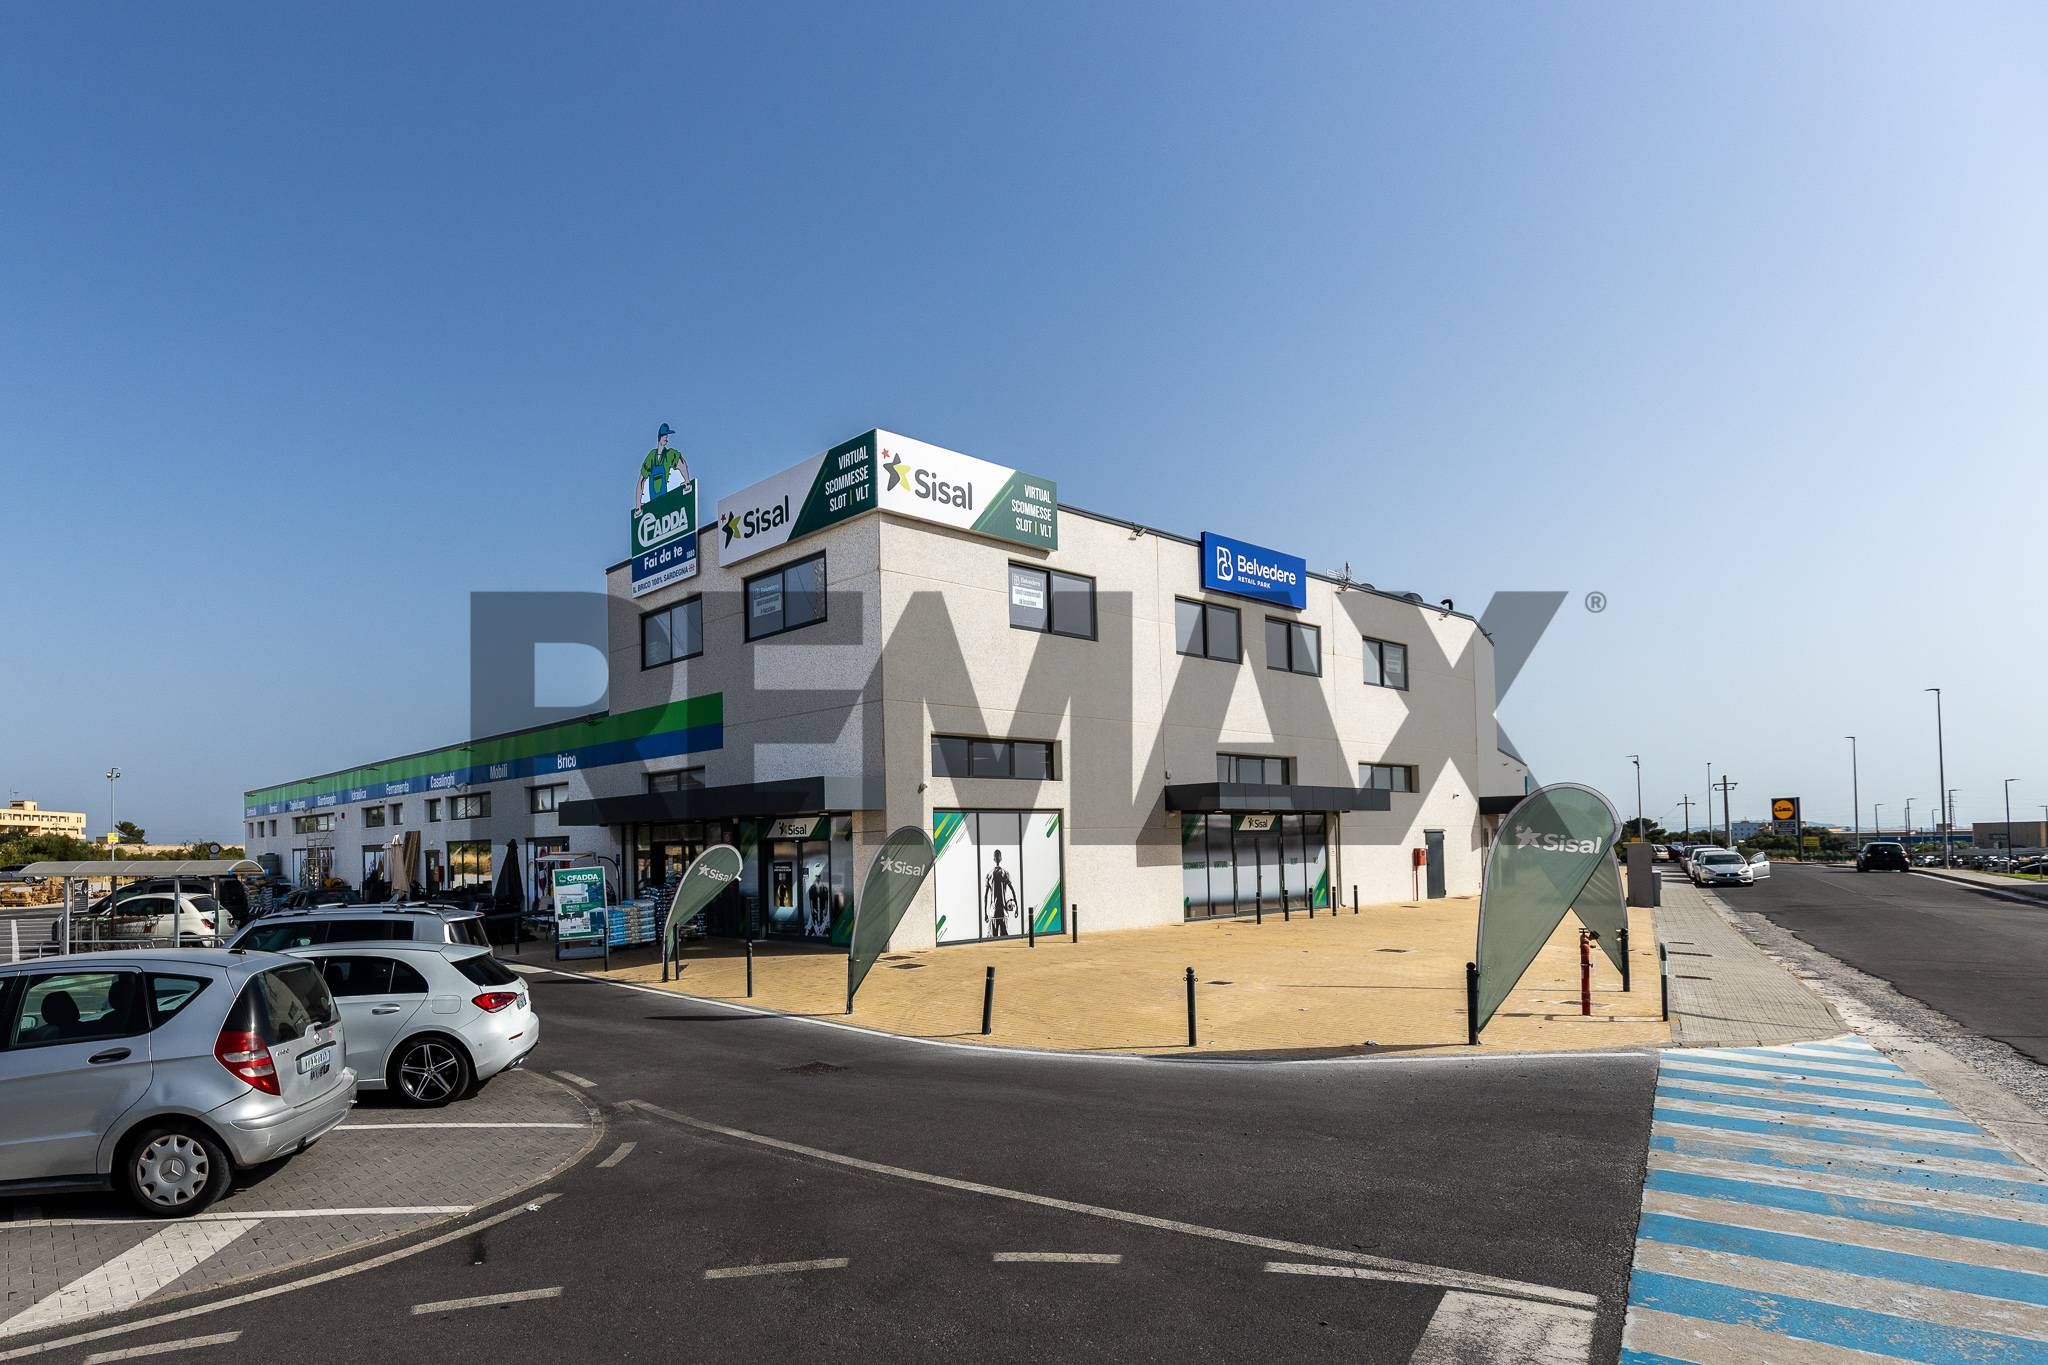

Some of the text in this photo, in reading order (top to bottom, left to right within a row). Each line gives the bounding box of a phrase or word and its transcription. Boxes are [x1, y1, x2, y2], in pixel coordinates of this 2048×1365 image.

[838, 445, 868, 470] VIRTUAL
[825, 465, 869, 495] SCOMMESSE
[914, 469, 973, 510] Sisal
[829, 484, 870, 512] SLOT VLT
[1024, 484, 1051, 504] VIRTUAL
[743, 495, 789, 539] Sisal
[1011, 499, 1052, 521] SCOMMESSE
[1015, 517, 1053, 538] SLOT VLT
[644, 545, 683, 571] Fai da te
[638, 581, 651, 592] BRICO
[651, 576, 663, 586] 100%
[663, 567, 688, 582] SARDEGNA
[1237, 555, 1296, 585] Belvedere
[1237, 576, 1271, 589] RETAIL PARK
[490, 763, 508, 779] Mobili
[557, 753, 577, 769] Brico
[386, 781, 410, 795] Ferramenta
[430, 772, 455, 788] Casalinghi
[788, 823, 807, 835] Sisal
[1254, 819, 1268, 829] Sisal
[1543, 833, 1602, 854] Sisal
[708, 868, 733, 883] Sisal
[893, 860, 925, 877] Sisal
